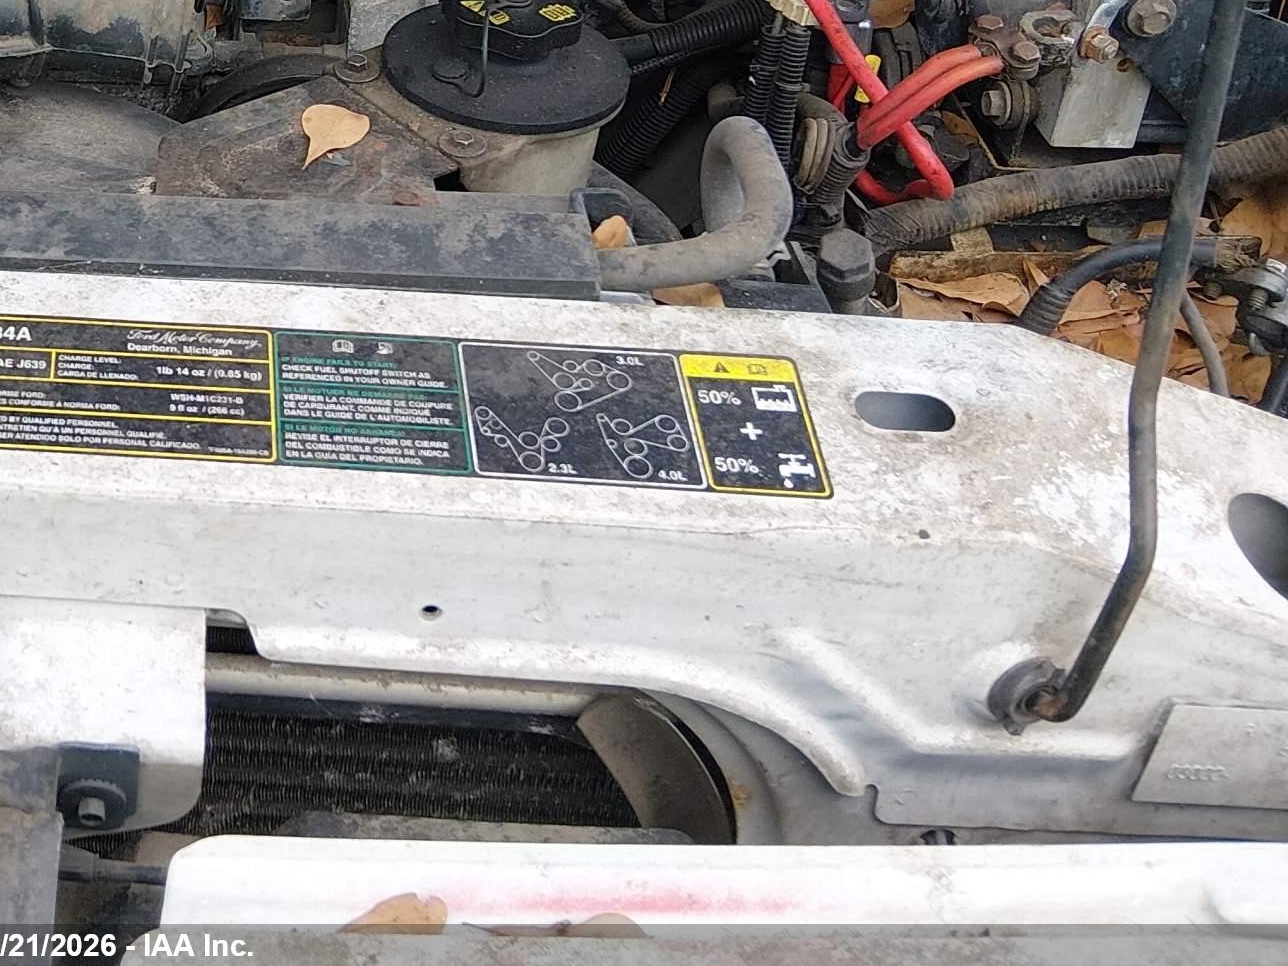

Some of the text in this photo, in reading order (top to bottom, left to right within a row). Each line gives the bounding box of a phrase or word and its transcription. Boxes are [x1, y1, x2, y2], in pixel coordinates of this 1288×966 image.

[127, 328, 261, 350] Ford Motor Company
[127, 342, 232, 356] Dearborn, Michigan
[16, 359, 46, 369] J639
[58, 354, 92, 362] CHARGE
[616, 356, 643, 366] 3.0L
[57, 361, 94, 370] CHARGE:
[281, 362, 430, 380] CHECK FUEL SHUTOFF SWITCH AS
[57, 369, 86, 377] CARGA
[176, 367, 189, 376] 14
[192, 367, 205, 377] oz
[213, 369, 240, 379] (0.85
[243, 370, 262, 380] kg)
[282, 371, 448, 389] REFERENCED IN YOUR OWNER GUIDE.
[7, 398, 53, 408] CONFORME
[325, 395, 337, 403] LA
[339, 396, 392, 406] COMMANDE
[408, 401, 453, 411] COUPURE
[697, 389, 742, 406] 50%
[186, 404, 198, 413] oz
[229, 407, 244, 415] cc)
[283, 400, 296, 408] DE
[357, 405, 392, 414] COMME
[283, 408, 309, 416] DANS
[324, 410, 353, 419] GUIDE
[8, 416, 20, 424] BY
[21, 416, 65, 425] QUALIFIED
[66, 418, 119, 428] PERSONNEL.
[74, 427, 124, 437] PERSONNEL
[14, 433, 56, 442] ATENDIDO
[102, 437, 147, 447] PERSONAL
[285, 431, 449, 449] REVISE EL INTERRUPTOR DE CIERRE
[285, 440, 303, 448] DEL
[305, 441, 370, 453] COMBUSTIBLE
[373, 446, 401, 455] COMO
[403, 448, 415, 456] SE
[285, 449, 298, 457] EN
[300, 450, 313, 458] LA
[339, 452, 357, 461] DEL
[359, 454, 423, 465] PROPIETARIO.
[548, 464, 577, 474] 2.3L
[714, 457, 760, 473] 50%
[659, 470, 688, 481] 4.0L
